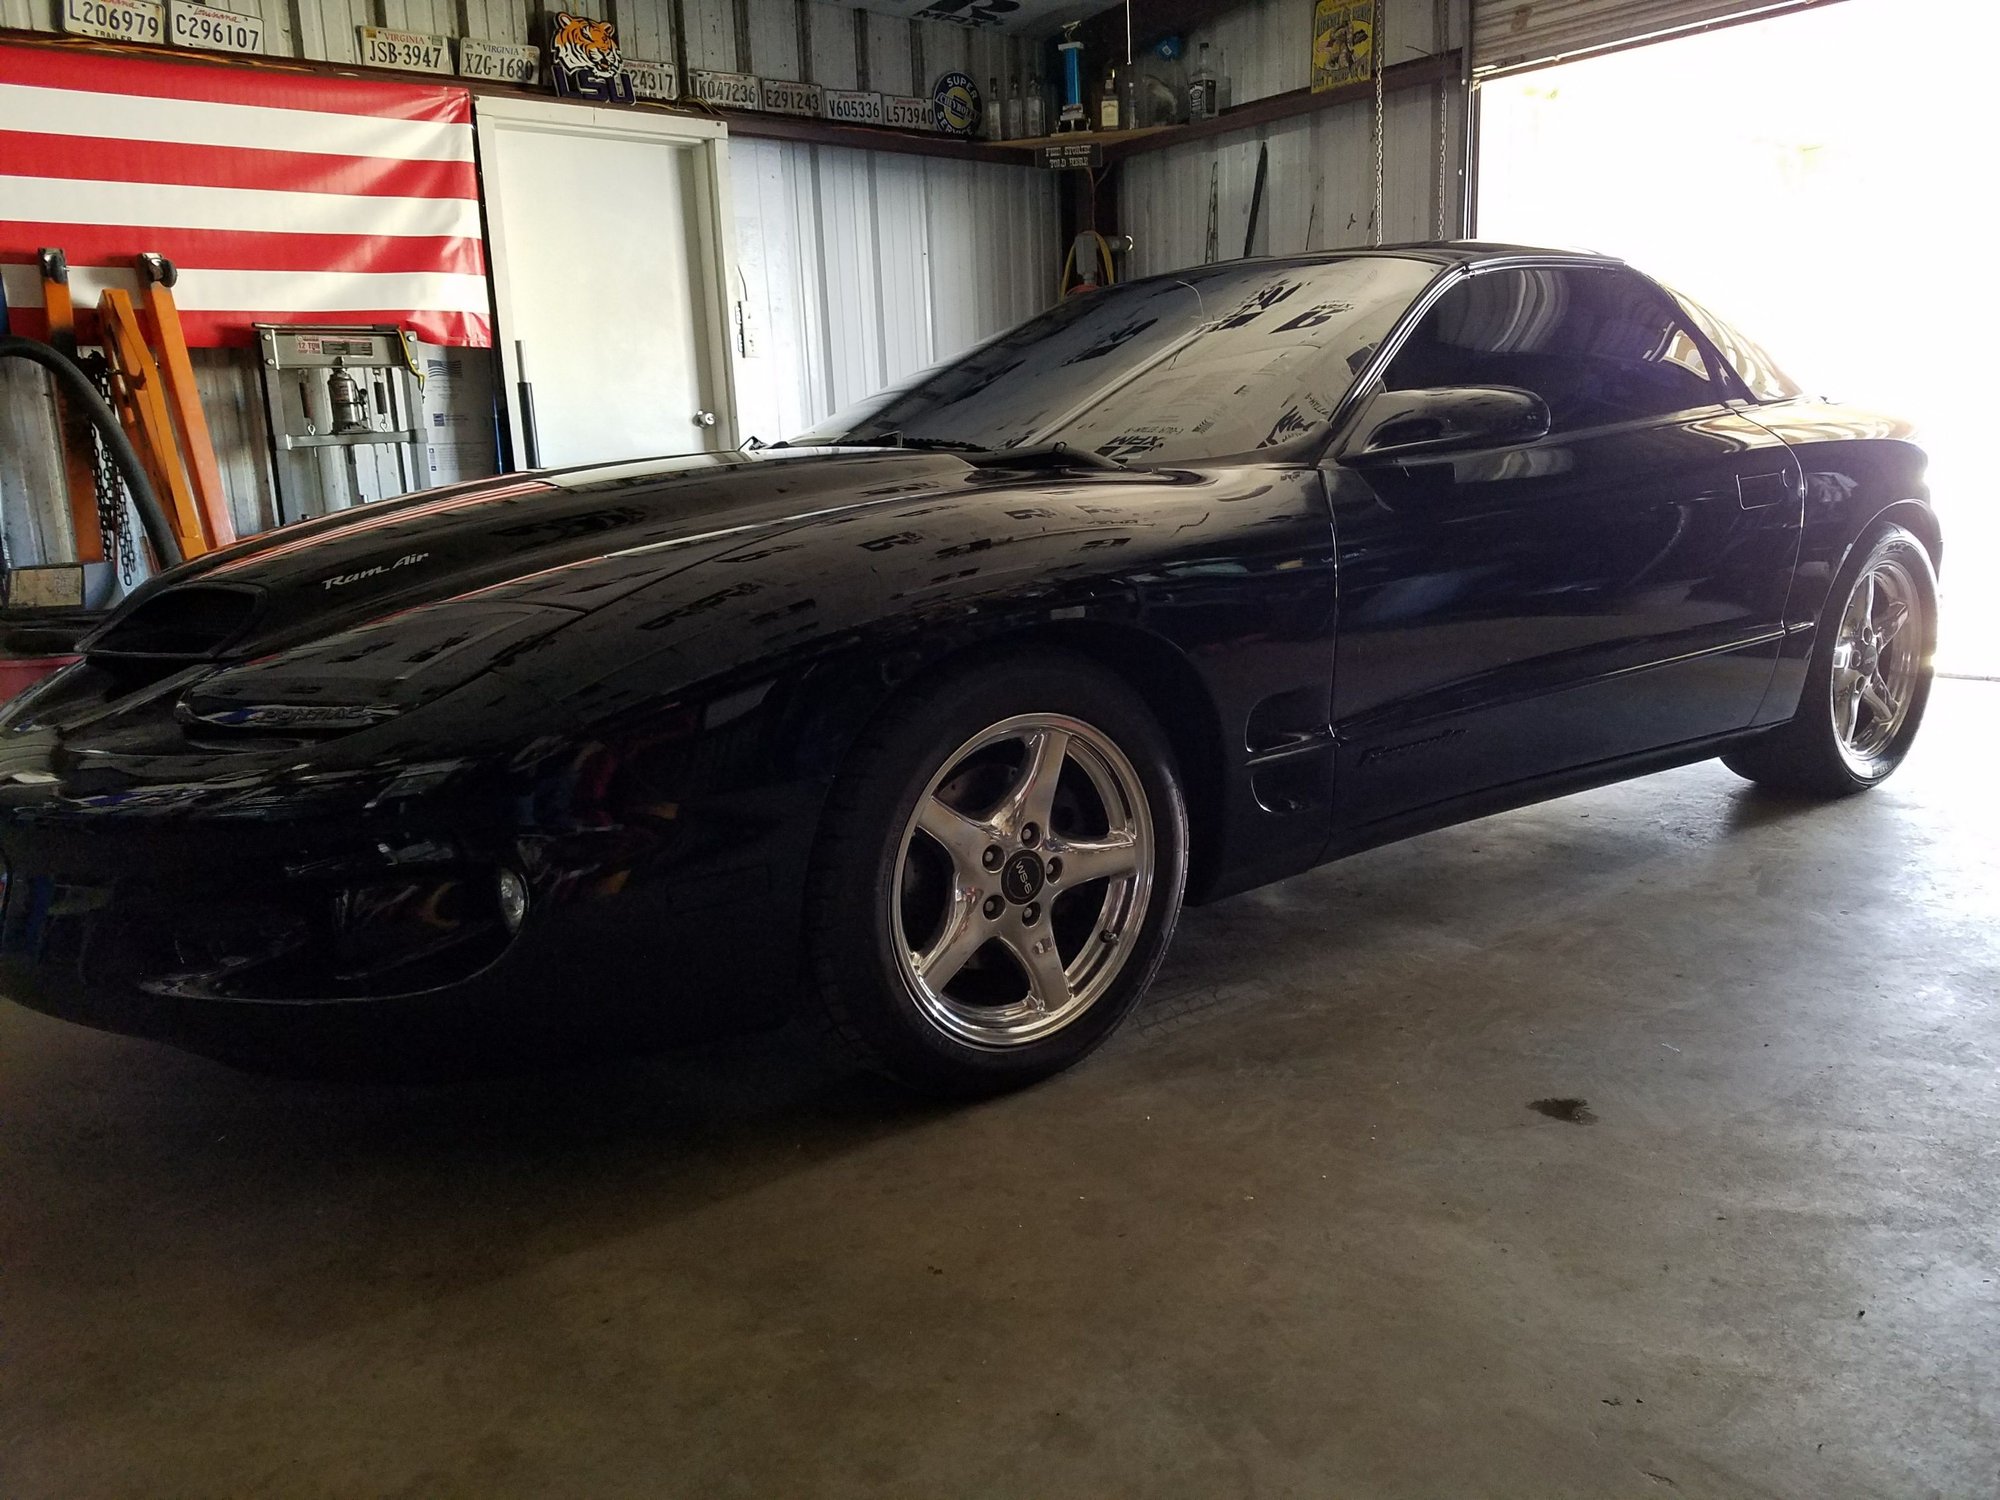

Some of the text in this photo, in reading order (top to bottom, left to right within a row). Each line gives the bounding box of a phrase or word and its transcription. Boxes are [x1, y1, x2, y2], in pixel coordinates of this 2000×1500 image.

[69, 0, 159, 38] L206979
[176, 14, 259, 51] C296107
[384, 32, 425, 45] VIRGINIA
[369, 40, 442, 68] JSB-3947
[482, 43, 520, 56] VIRGINIA
[464, 52, 534, 81] XZG-1680
[551, 63, 637, 107] LSU
[946, 75, 978, 99] SUPER
[766, 90, 820, 111] E291243
[829, 99, 880, 118] V605336
[886, 105, 934, 125] L573940
[321, 552, 429, 590] Ram Air
